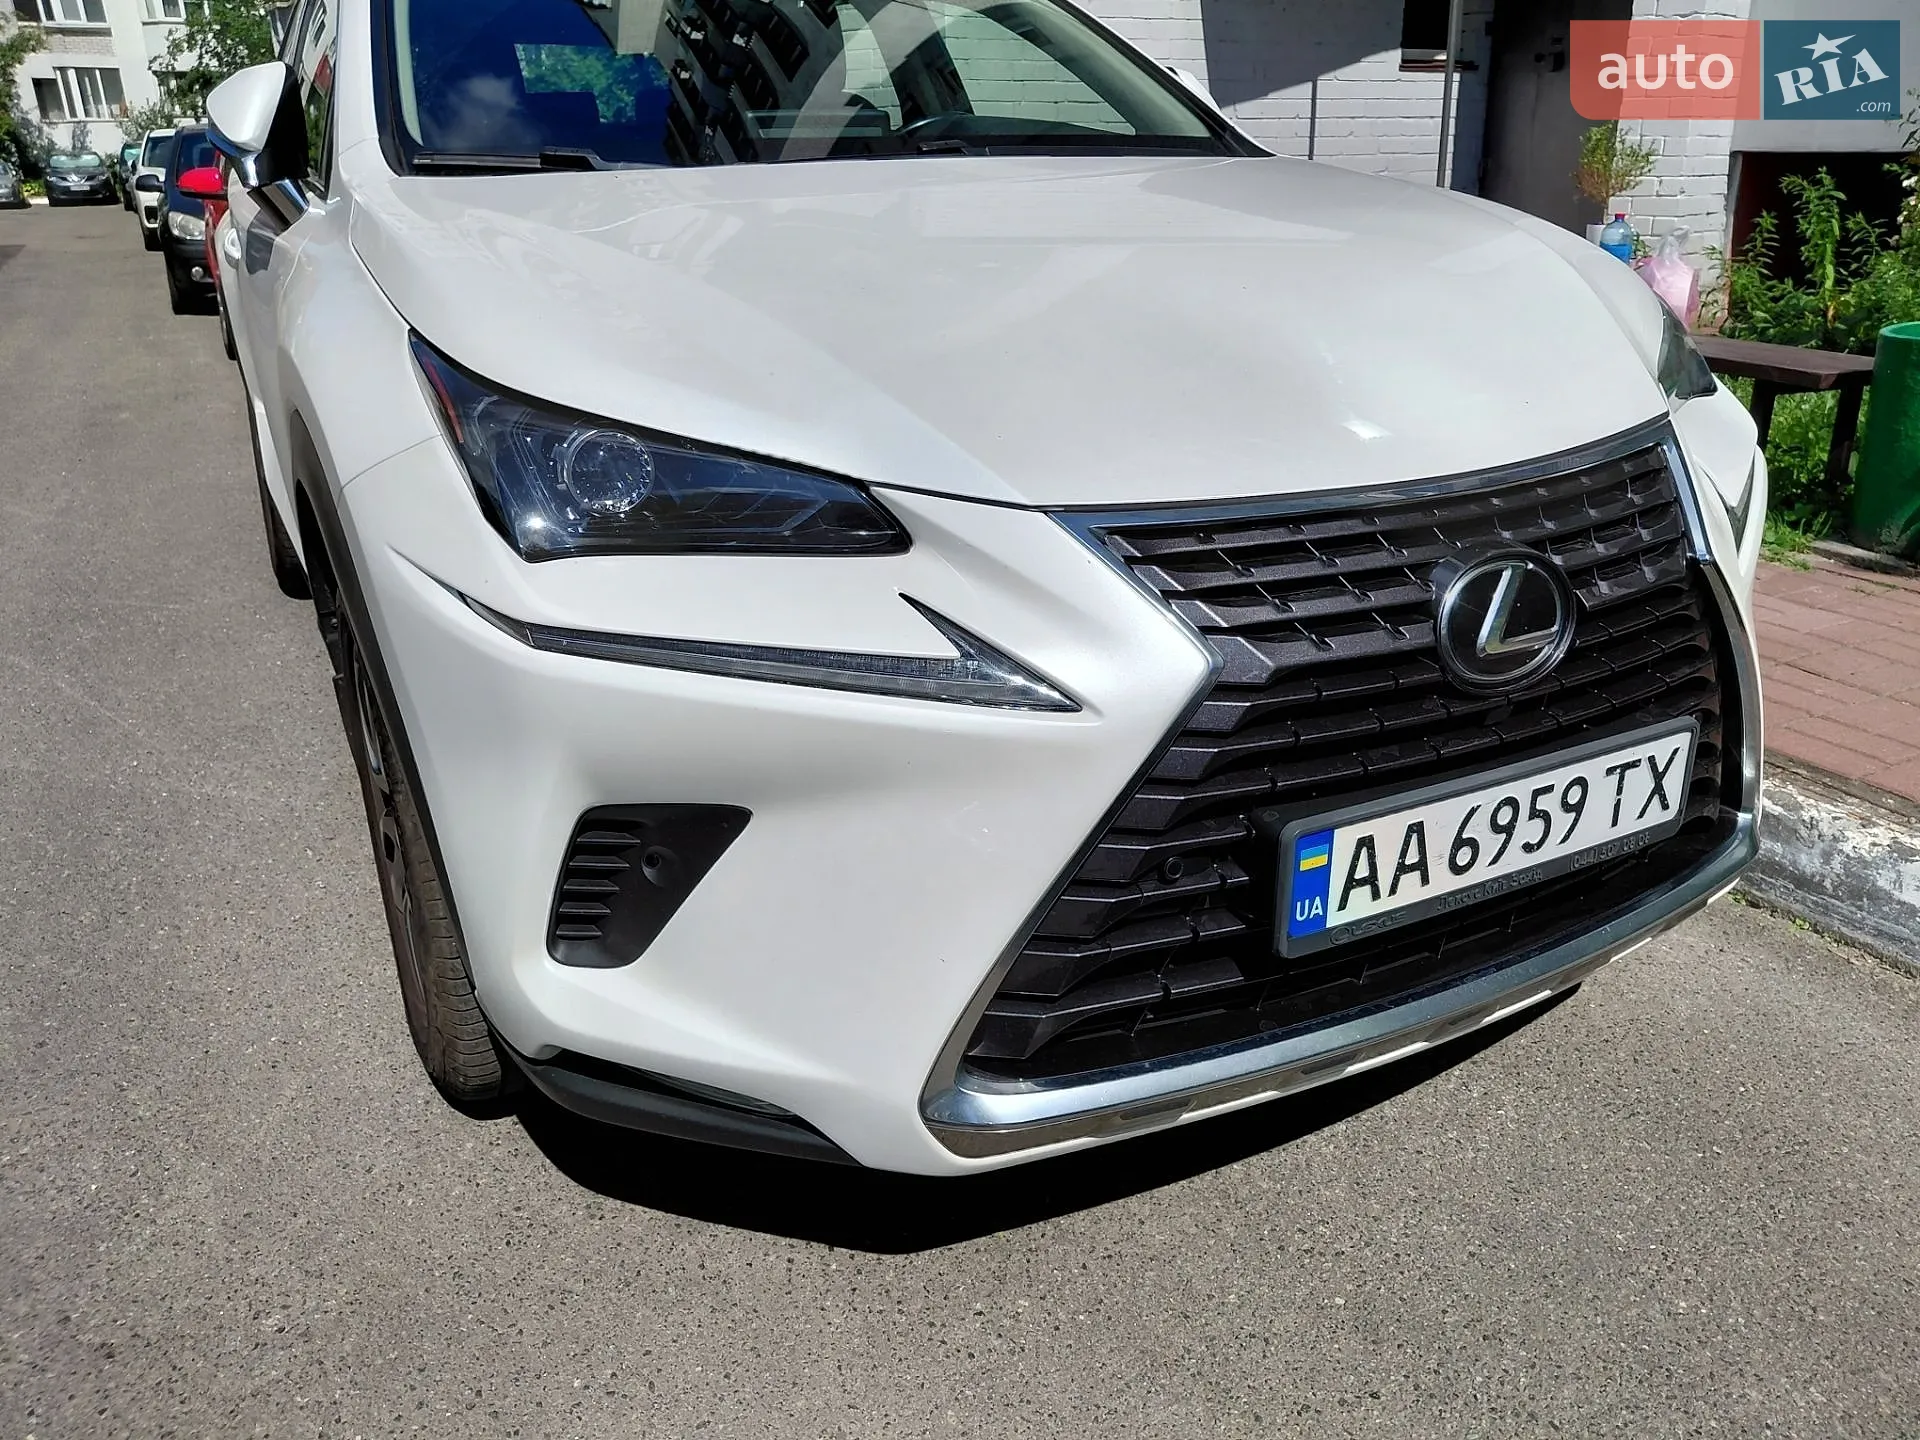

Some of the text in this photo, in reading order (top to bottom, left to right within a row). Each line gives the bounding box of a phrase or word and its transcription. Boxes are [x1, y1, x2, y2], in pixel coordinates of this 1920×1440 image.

[1336, 746, 1681, 912] AA 6959 TX
[1295, 899, 1324, 922] UA
